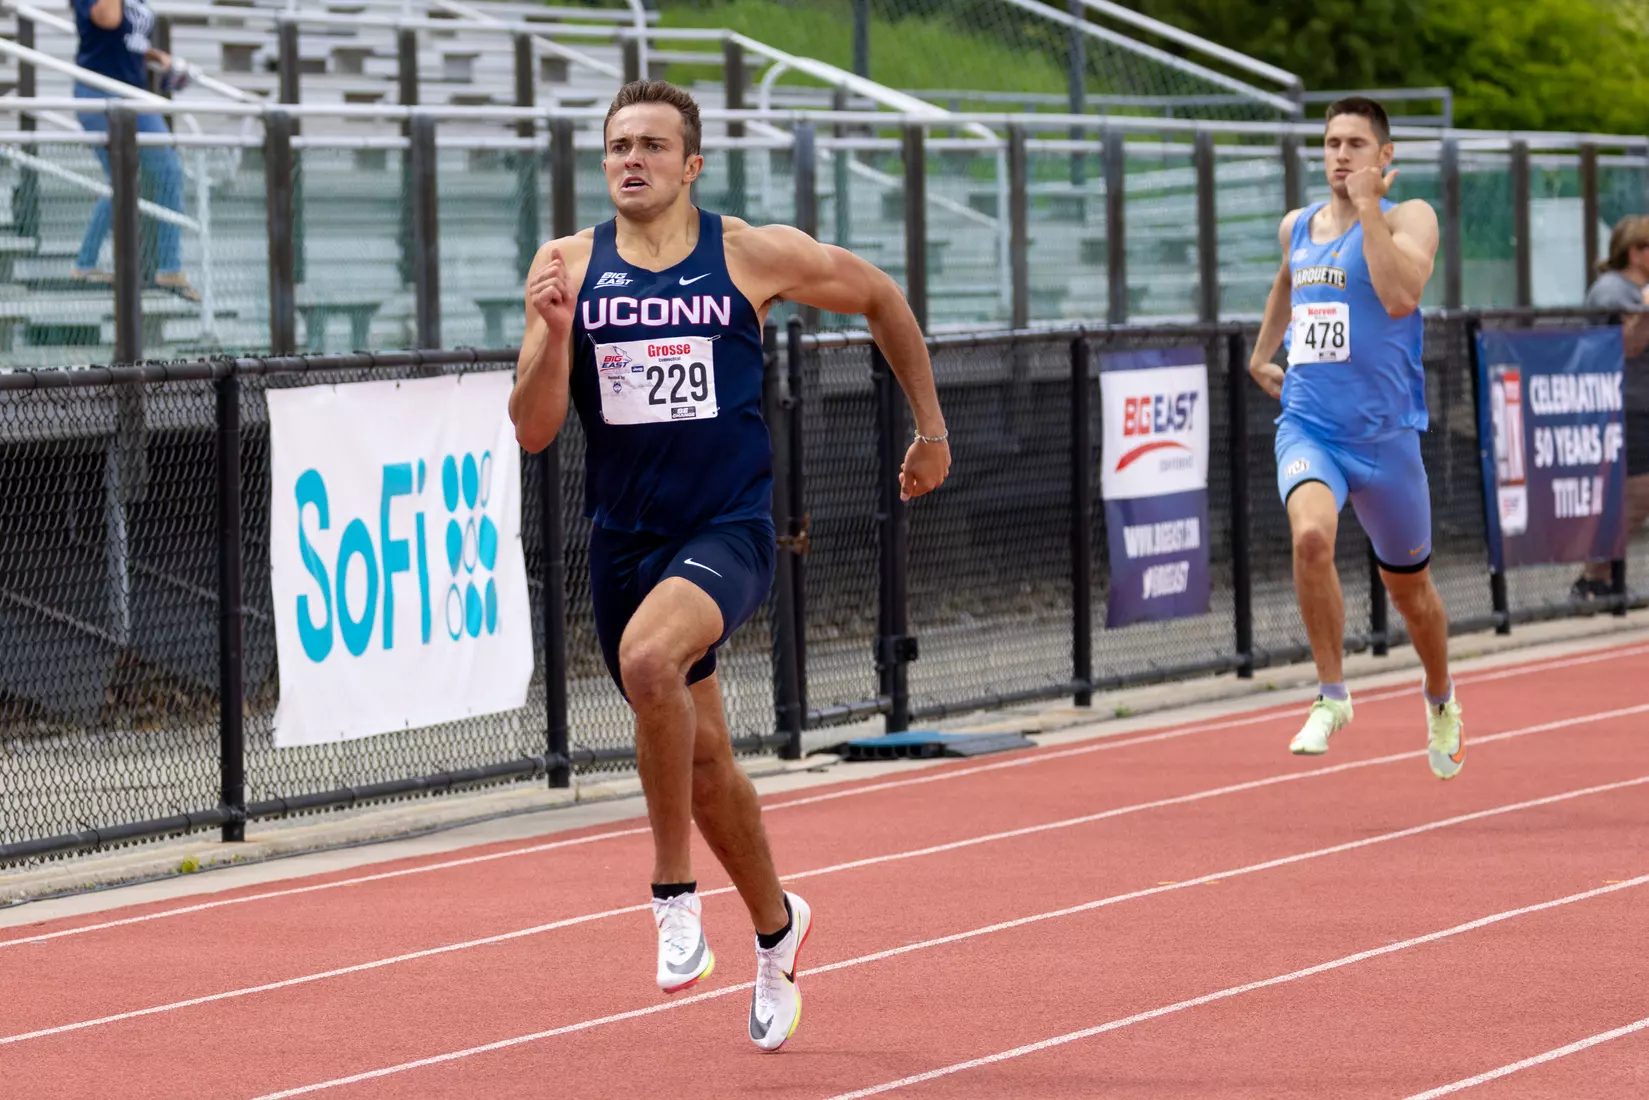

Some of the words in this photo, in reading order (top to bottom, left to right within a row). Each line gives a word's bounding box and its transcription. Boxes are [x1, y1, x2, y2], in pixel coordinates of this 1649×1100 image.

[582, 295, 731, 330] UCONN
[647, 343, 691, 358] Grosse
[1305, 321, 1345, 349] 478
[646, 362, 708, 405] 229
[1529, 372, 1623, 414] CELEBRATING
[1534, 427, 1553, 468] 50
[1554, 424, 1602, 467] YEARS
[1552, 477, 1591, 518] TITLE
[295, 457, 431, 663] SoFi
